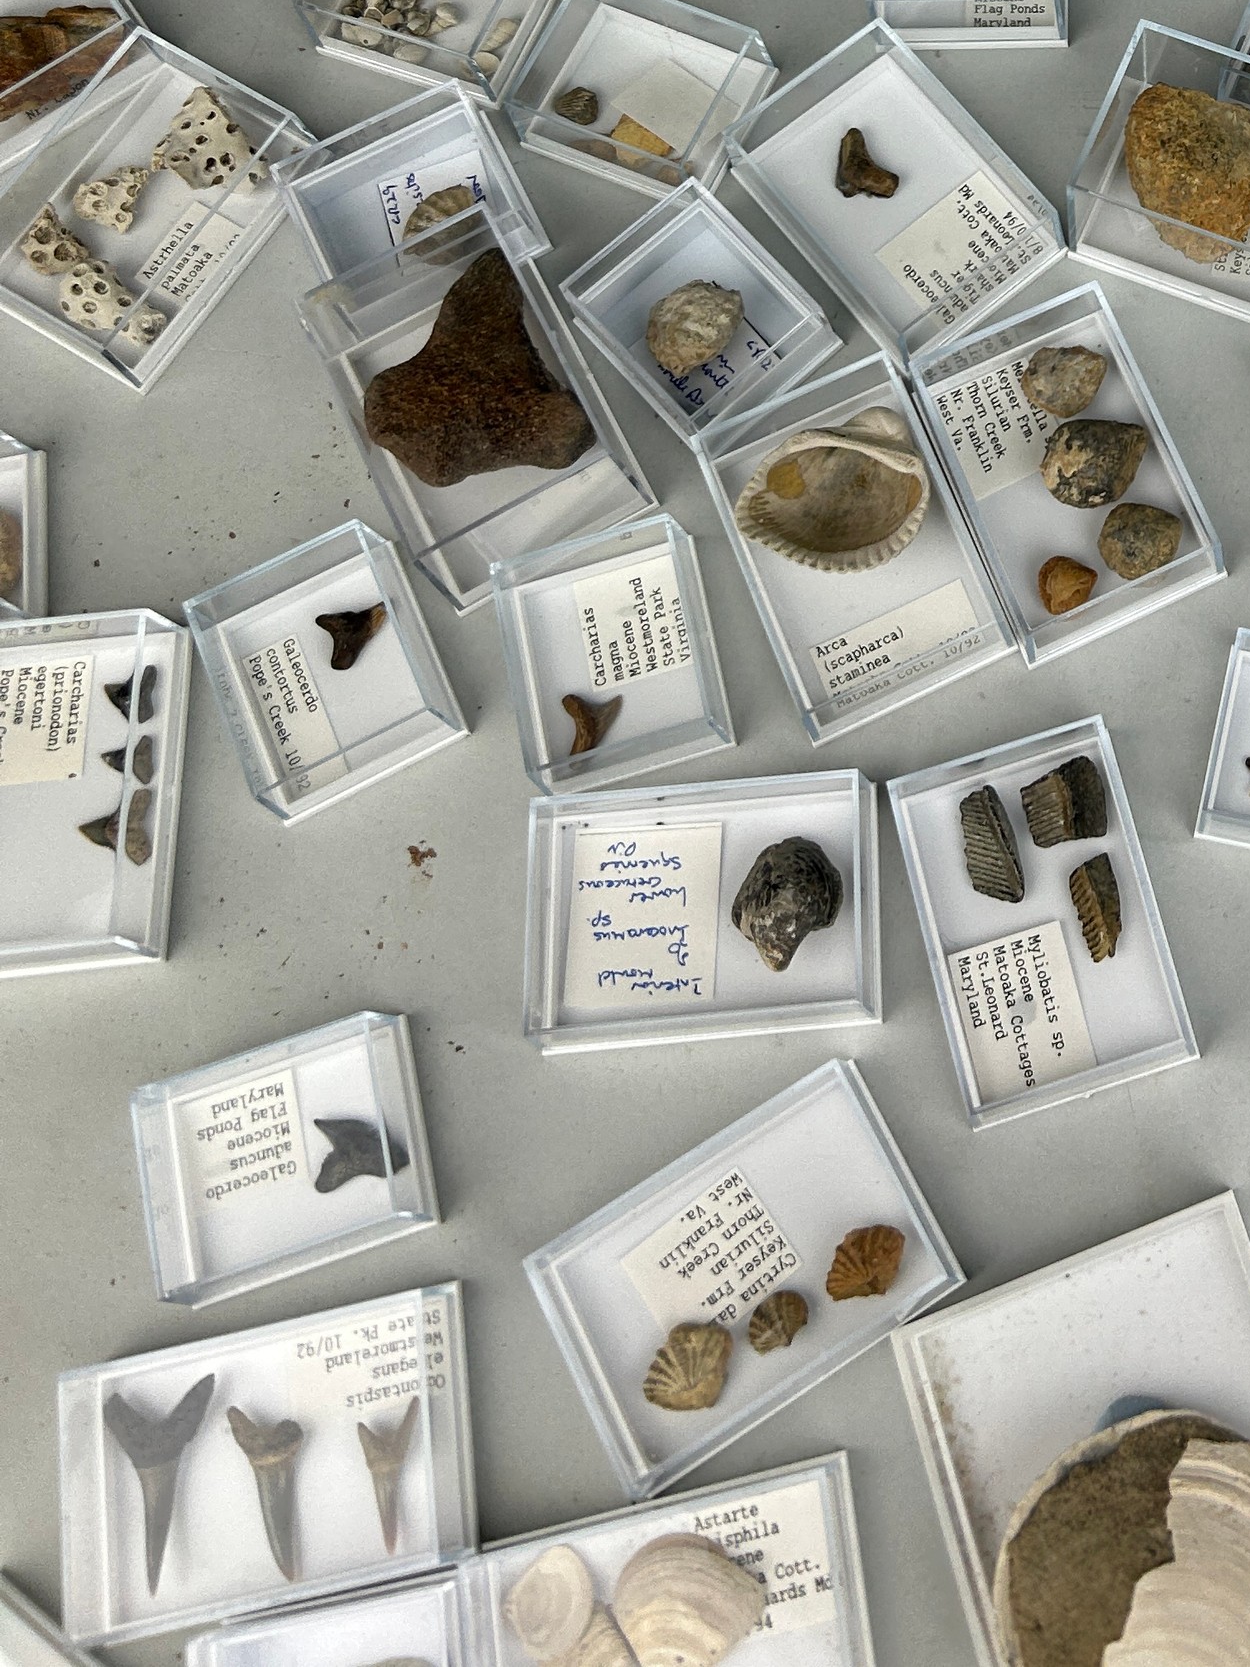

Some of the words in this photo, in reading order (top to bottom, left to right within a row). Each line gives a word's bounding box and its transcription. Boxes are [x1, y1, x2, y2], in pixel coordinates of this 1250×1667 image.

[972, 16, 1031, 27] Maryland
[955, 199, 980, 230] Cott.
[957, 183, 974, 201] Md
[973, 199, 1015, 245] Leonards
[141, 221, 194, 279] Astrhella
[160, 243, 200, 291] palmata
[169, 251, 213, 297] Matoaka
[980, 375, 1011, 432] Silurian
[994, 367, 1021, 410] Keyser
[1015, 413, 1033, 443] Frm.
[583, 606, 607, 687] Carcharias
[632, 576, 658, 673] Westmoreland
[670, 596, 690, 663] Virginia
[814, 637, 848, 658] Arca
[823, 625, 904, 673] (scapharca)
[265, 647, 298, 714] contortus
[282, 637, 318, 713] Galeocerdo
[828, 653, 891, 689] staminea
[29, 665, 47, 731] egertoni
[44, 665, 68, 752] (prionodon)
[65, 660, 86, 744] Carcharias
[957, 955, 986, 1029] Maryland
[975, 950, 1008, 1041] St.Leonard
[1009, 938, 1034, 1002] Miocene
[209, 1081, 284, 1118] Maryland
[204, 1159, 297, 1199] Galeocerdo
[228, 1140, 292, 1171] aduncus
[709, 1218, 774, 1276] Silurian
[738, 1252, 797, 1302] Cyrtina
[694, 1504, 759, 1532] Astarte
[773, 1558, 820, 1580] Cott.
